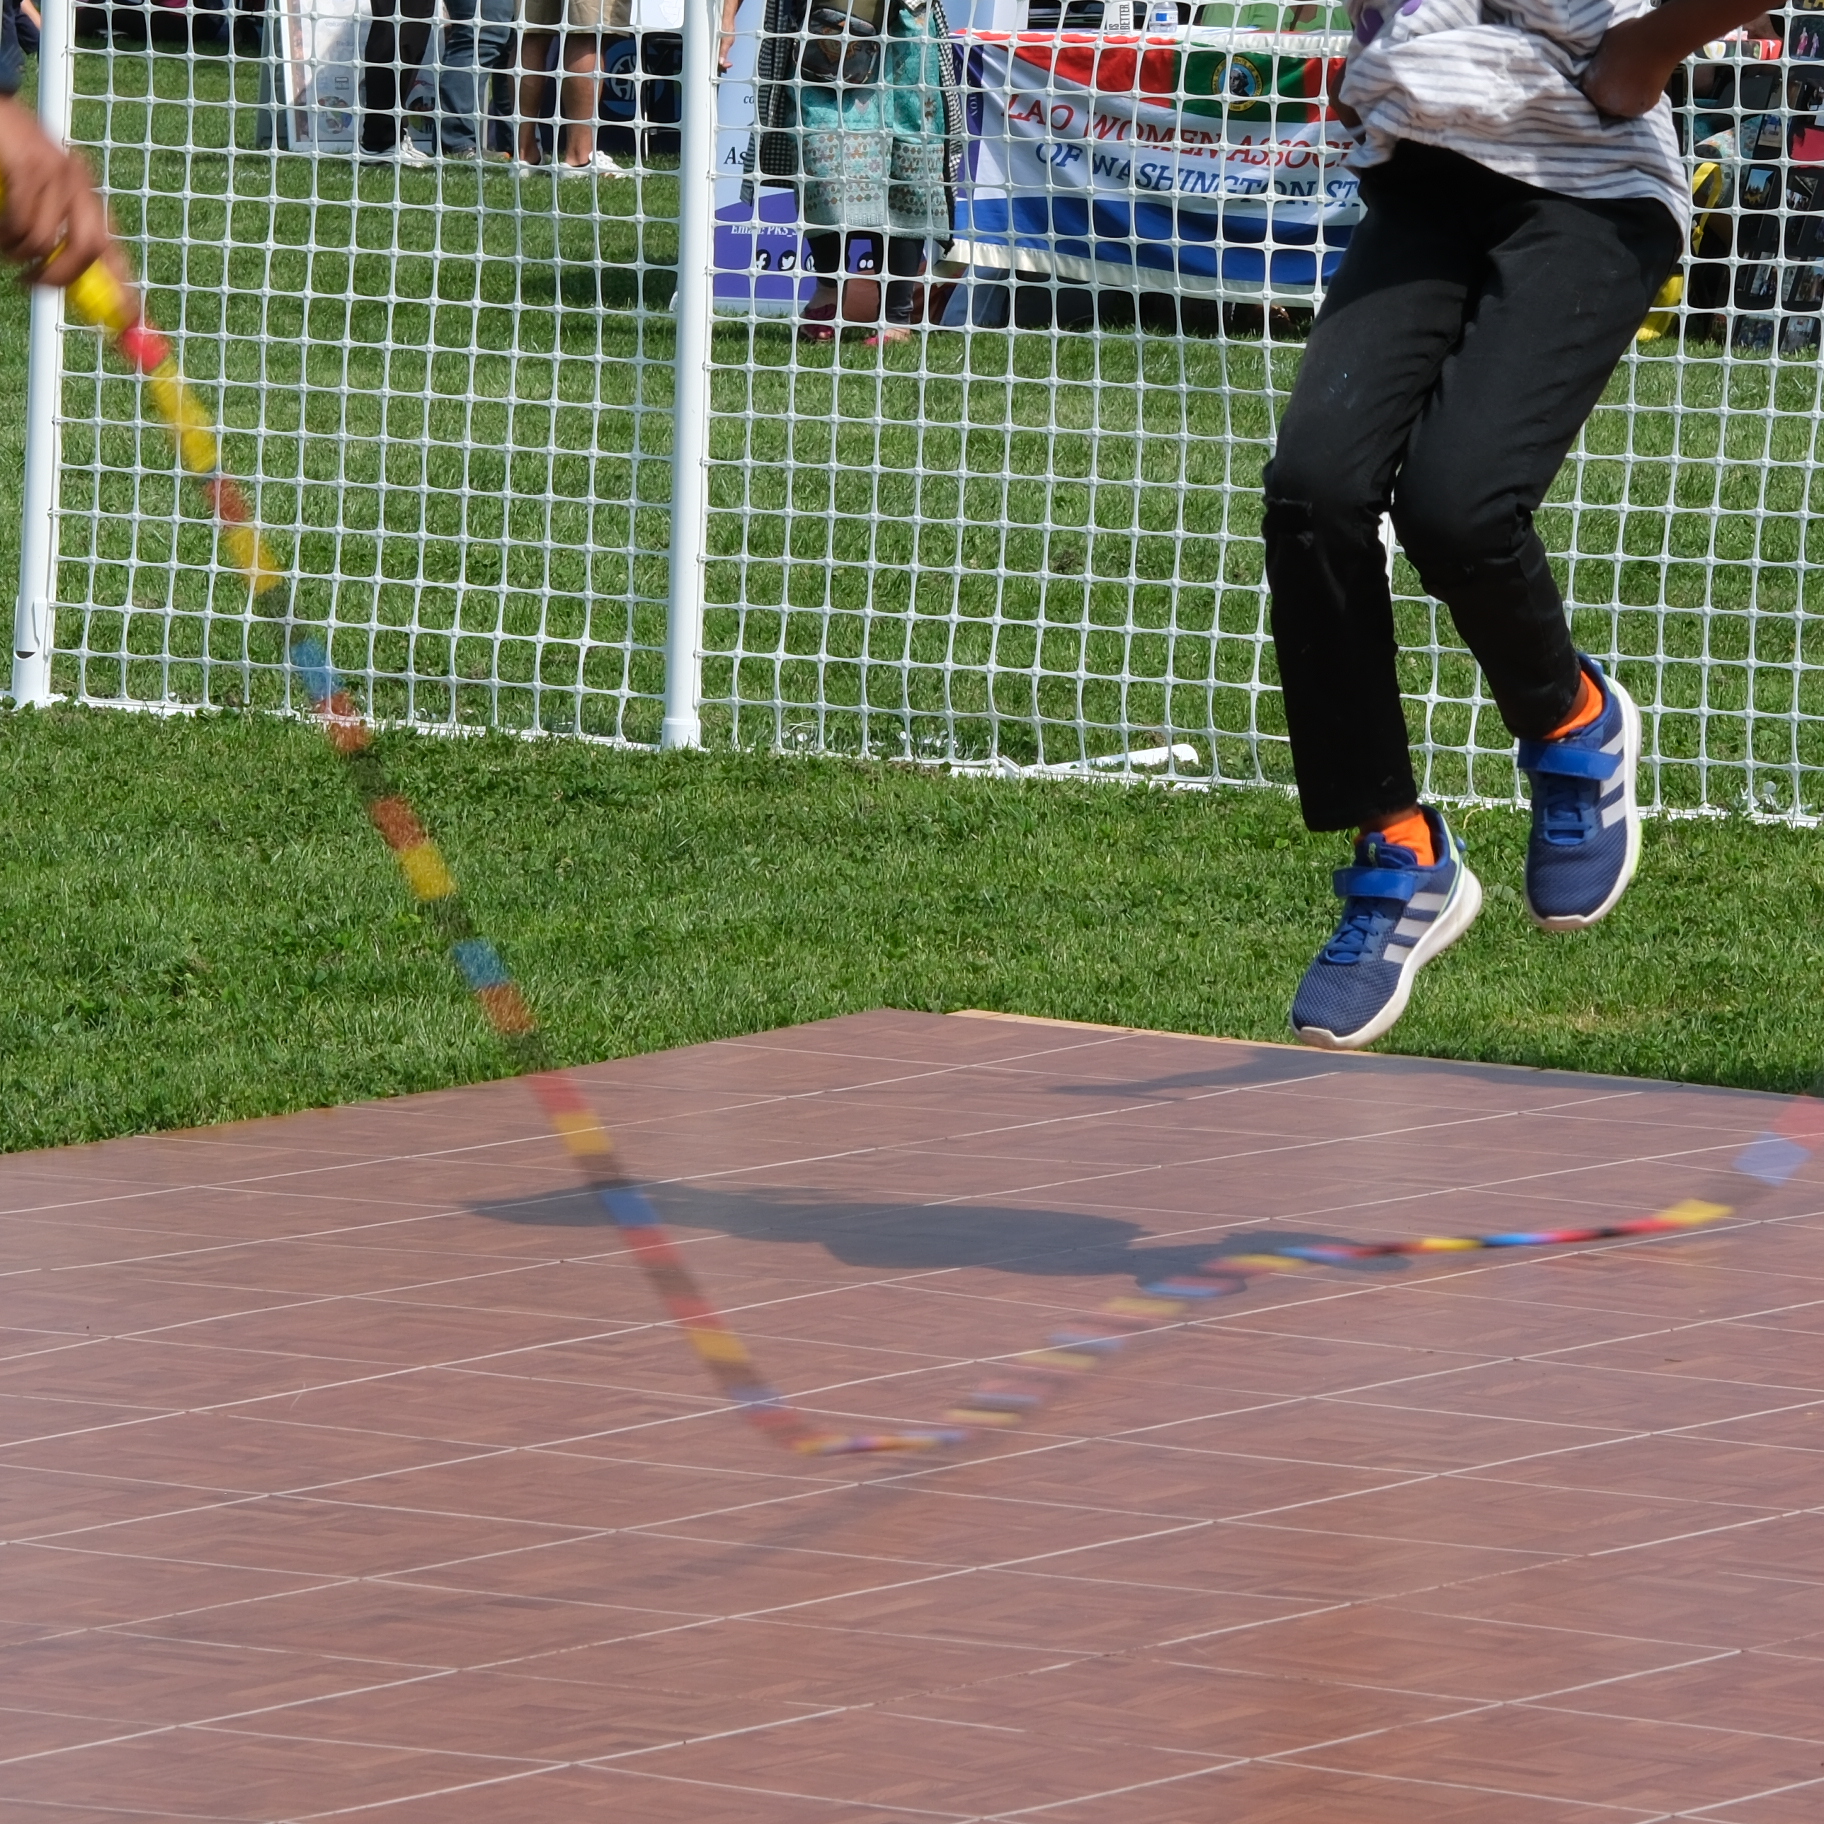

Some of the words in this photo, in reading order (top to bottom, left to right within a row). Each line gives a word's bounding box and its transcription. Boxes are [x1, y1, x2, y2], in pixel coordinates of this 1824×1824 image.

[1119, 3, 1130, 30] BETTER
[1000, 93, 1074, 131] LAO
[1083, 111, 1222, 158] WOMEN
[1036, 142, 1082, 168] OF
[1090, 152, 1317, 208] WASHINGTON
